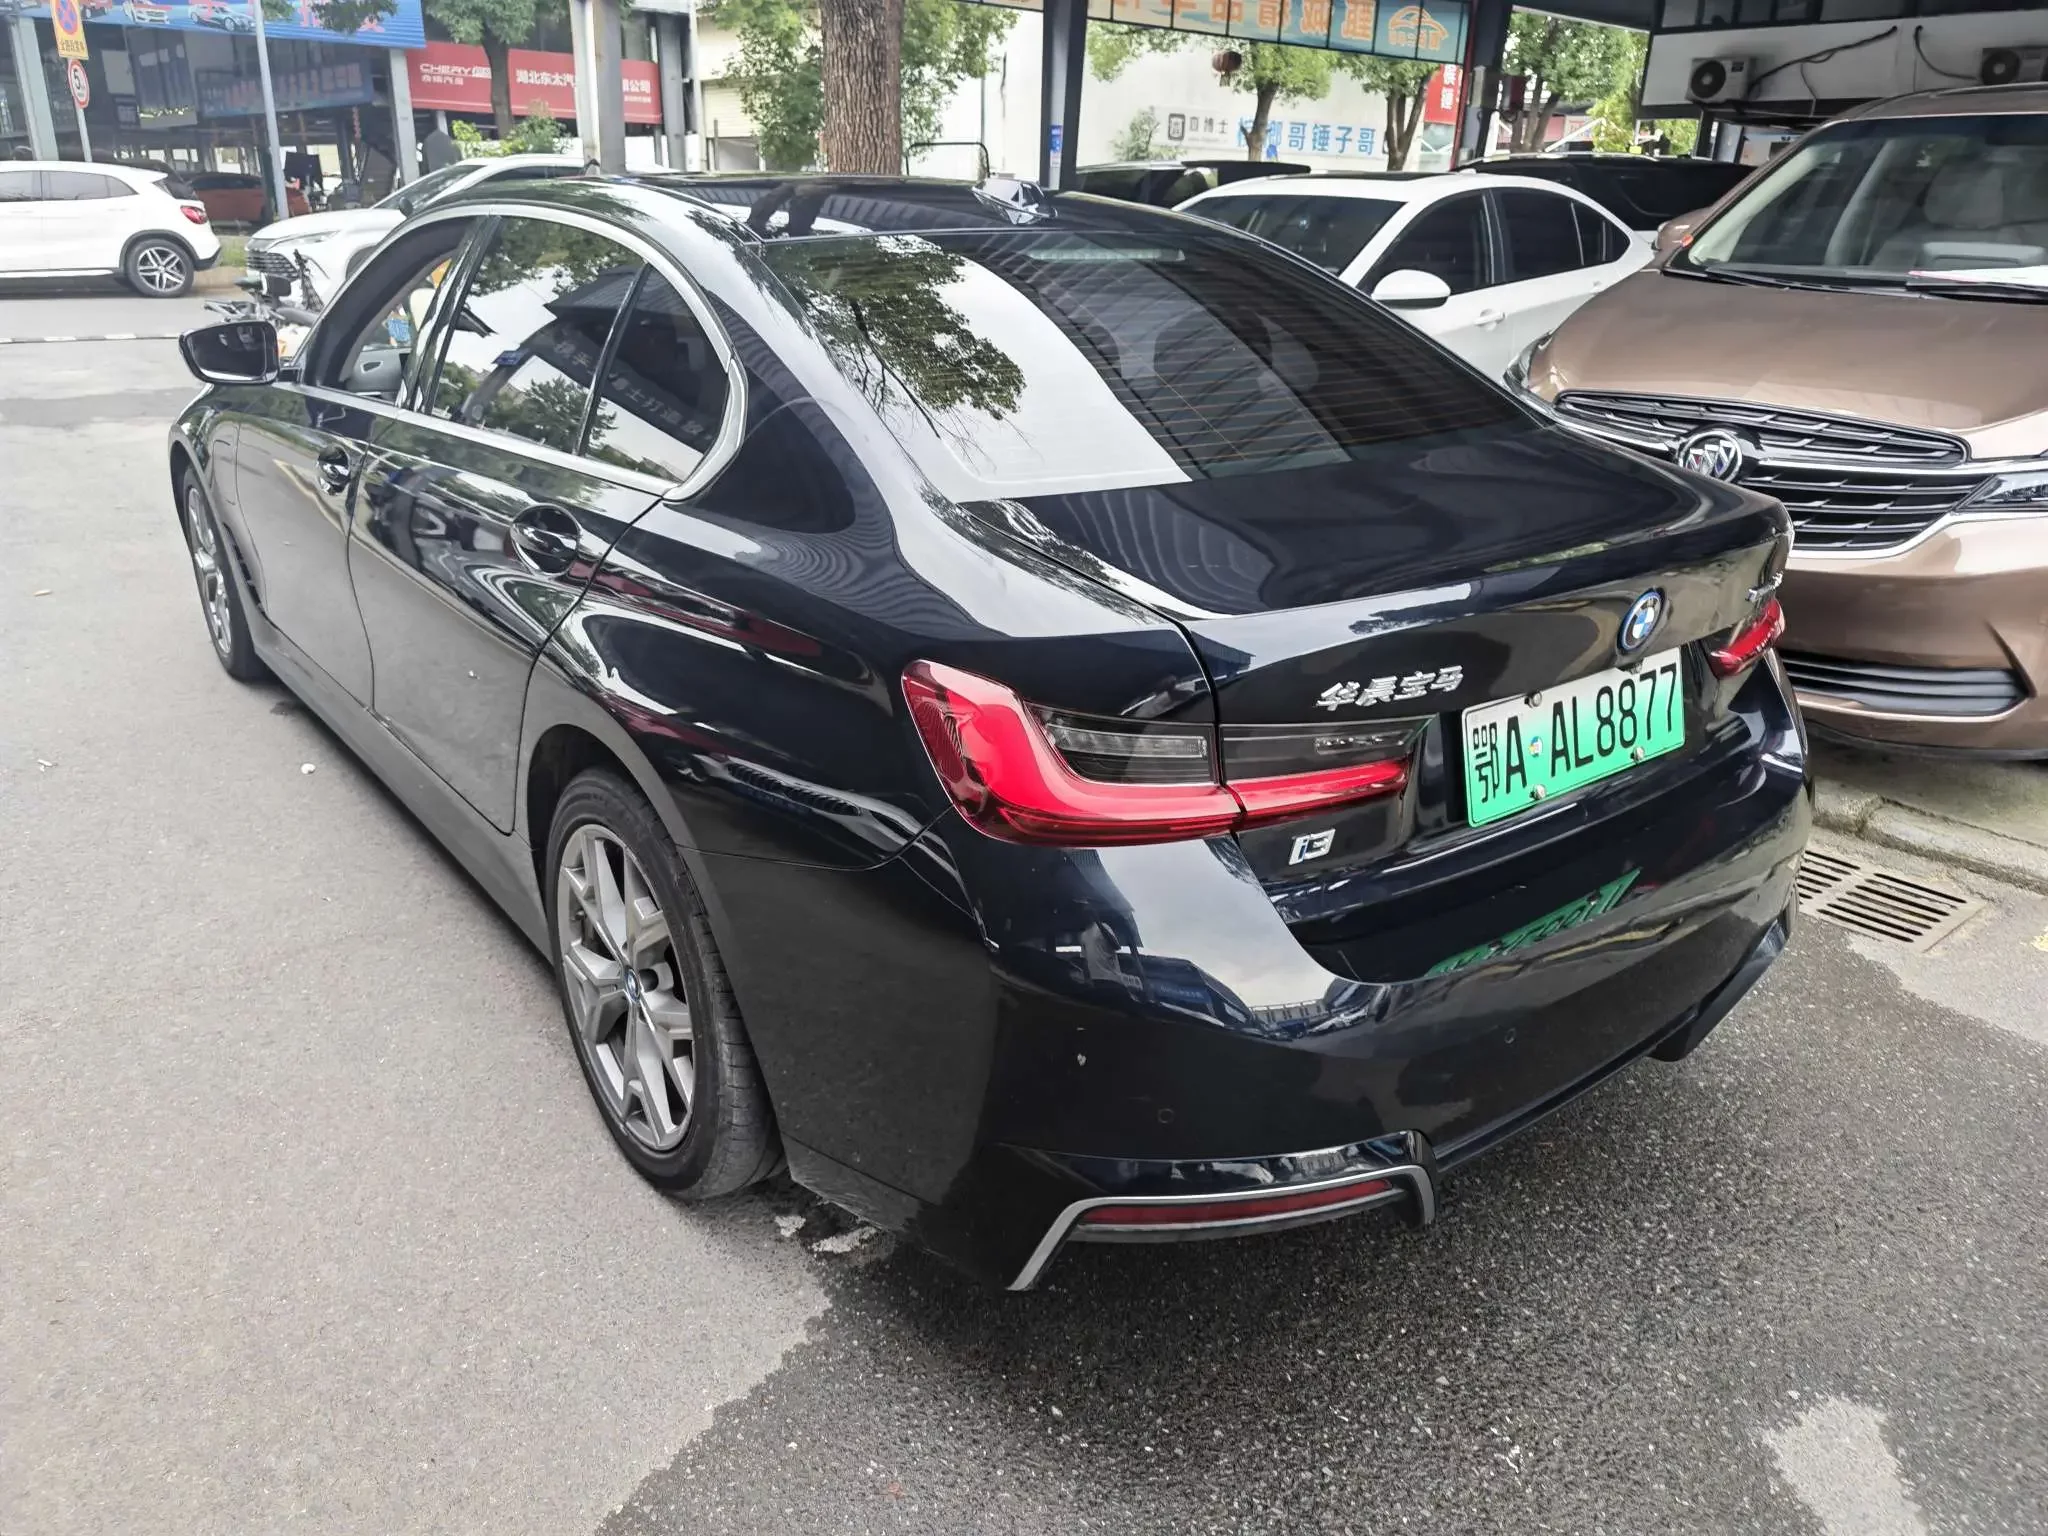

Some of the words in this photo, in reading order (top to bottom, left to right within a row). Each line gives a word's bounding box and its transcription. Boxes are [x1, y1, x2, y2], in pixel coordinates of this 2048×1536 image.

[1315, 665, 1464, 711] 华晨宝马
[1289, 828, 1336, 865] i3
